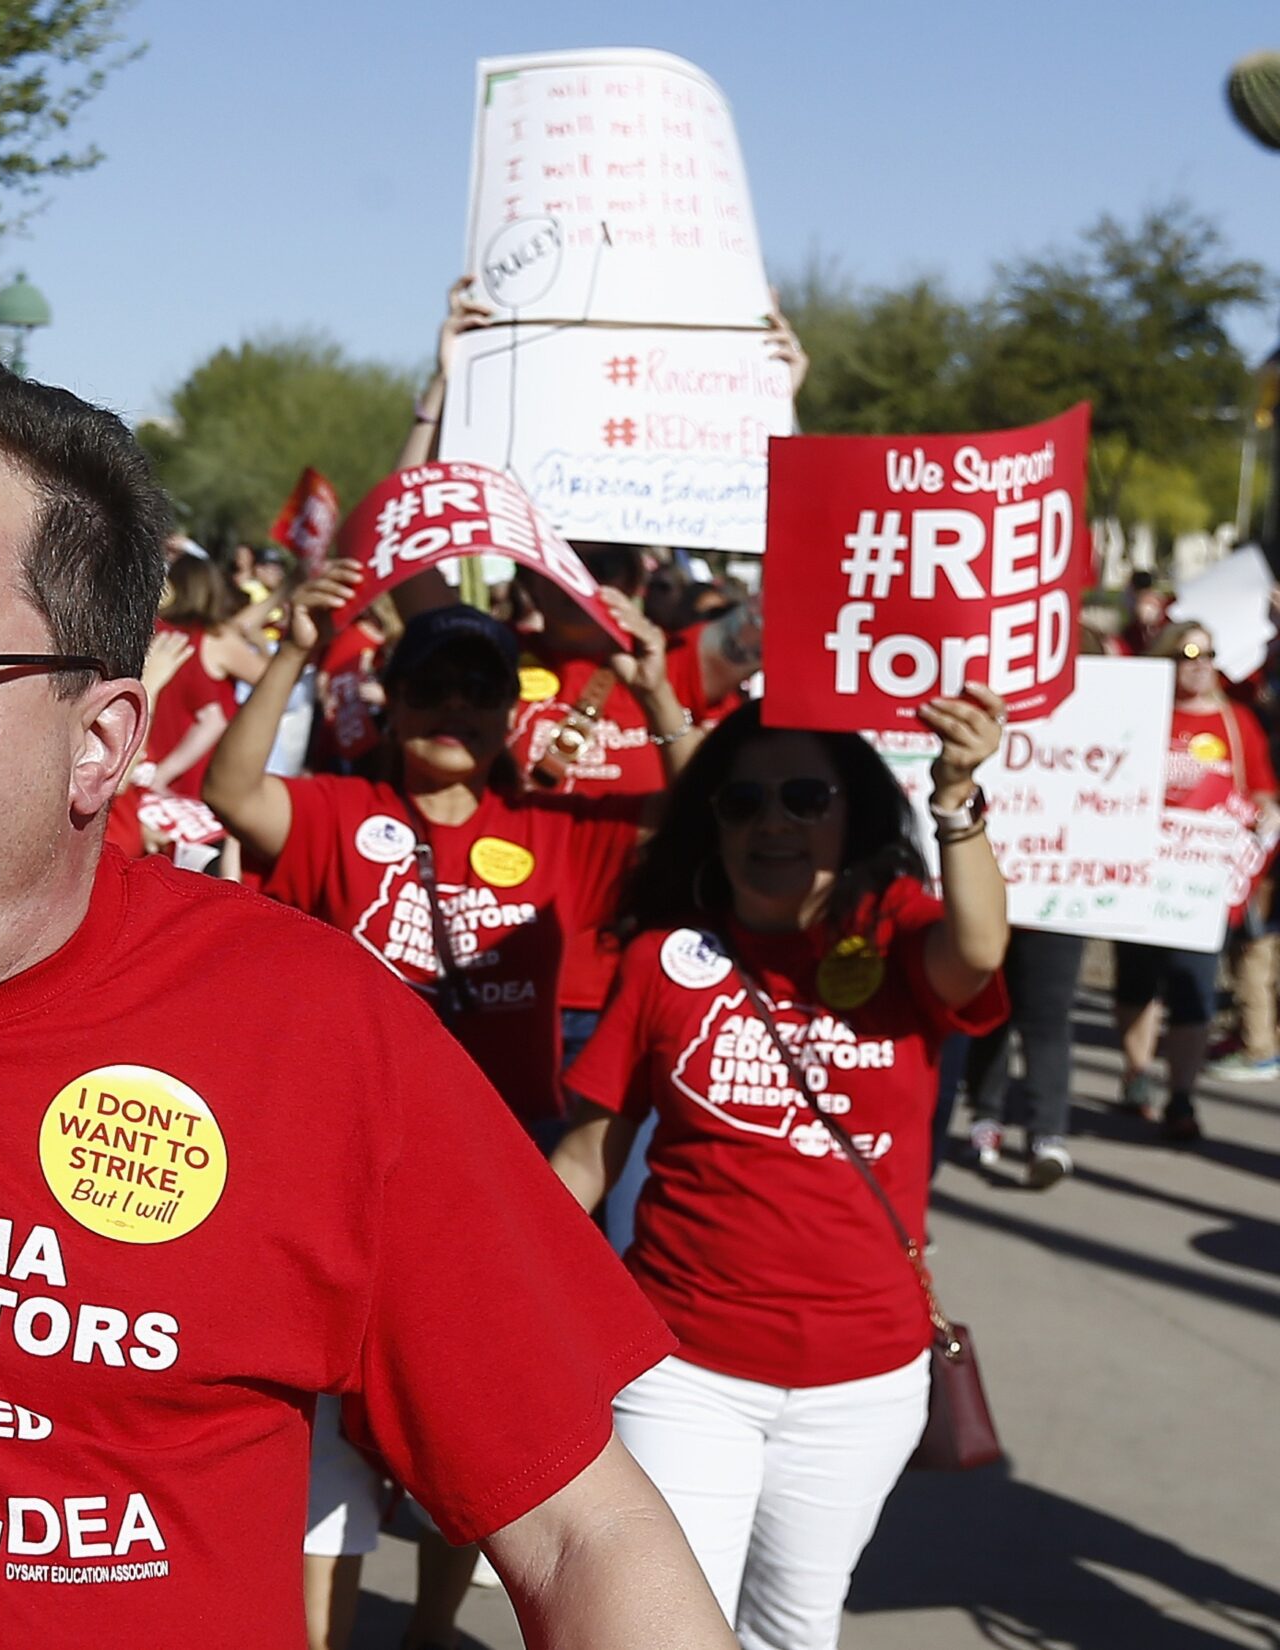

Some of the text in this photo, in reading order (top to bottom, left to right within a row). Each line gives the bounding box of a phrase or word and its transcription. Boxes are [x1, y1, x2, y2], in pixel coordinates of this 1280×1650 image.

[886, 440, 1054, 503] We Support
[841, 488, 1073, 600] #RED
[824, 589, 1071, 698] forED
[1004, 730, 1128, 781] Ducey
[483, 981, 536, 1004] DEA
[78, 1087, 201, 1137] I DON'T
[59, 1112, 210, 1170] WANT TO
[69, 1146, 185, 1199] STRIKE,
[71, 1178, 179, 1224] But I will
[8, 1492, 166, 1558] DEA
[6, 1560, 169, 1584] DYSART EDUCATION ASSOCIATION
